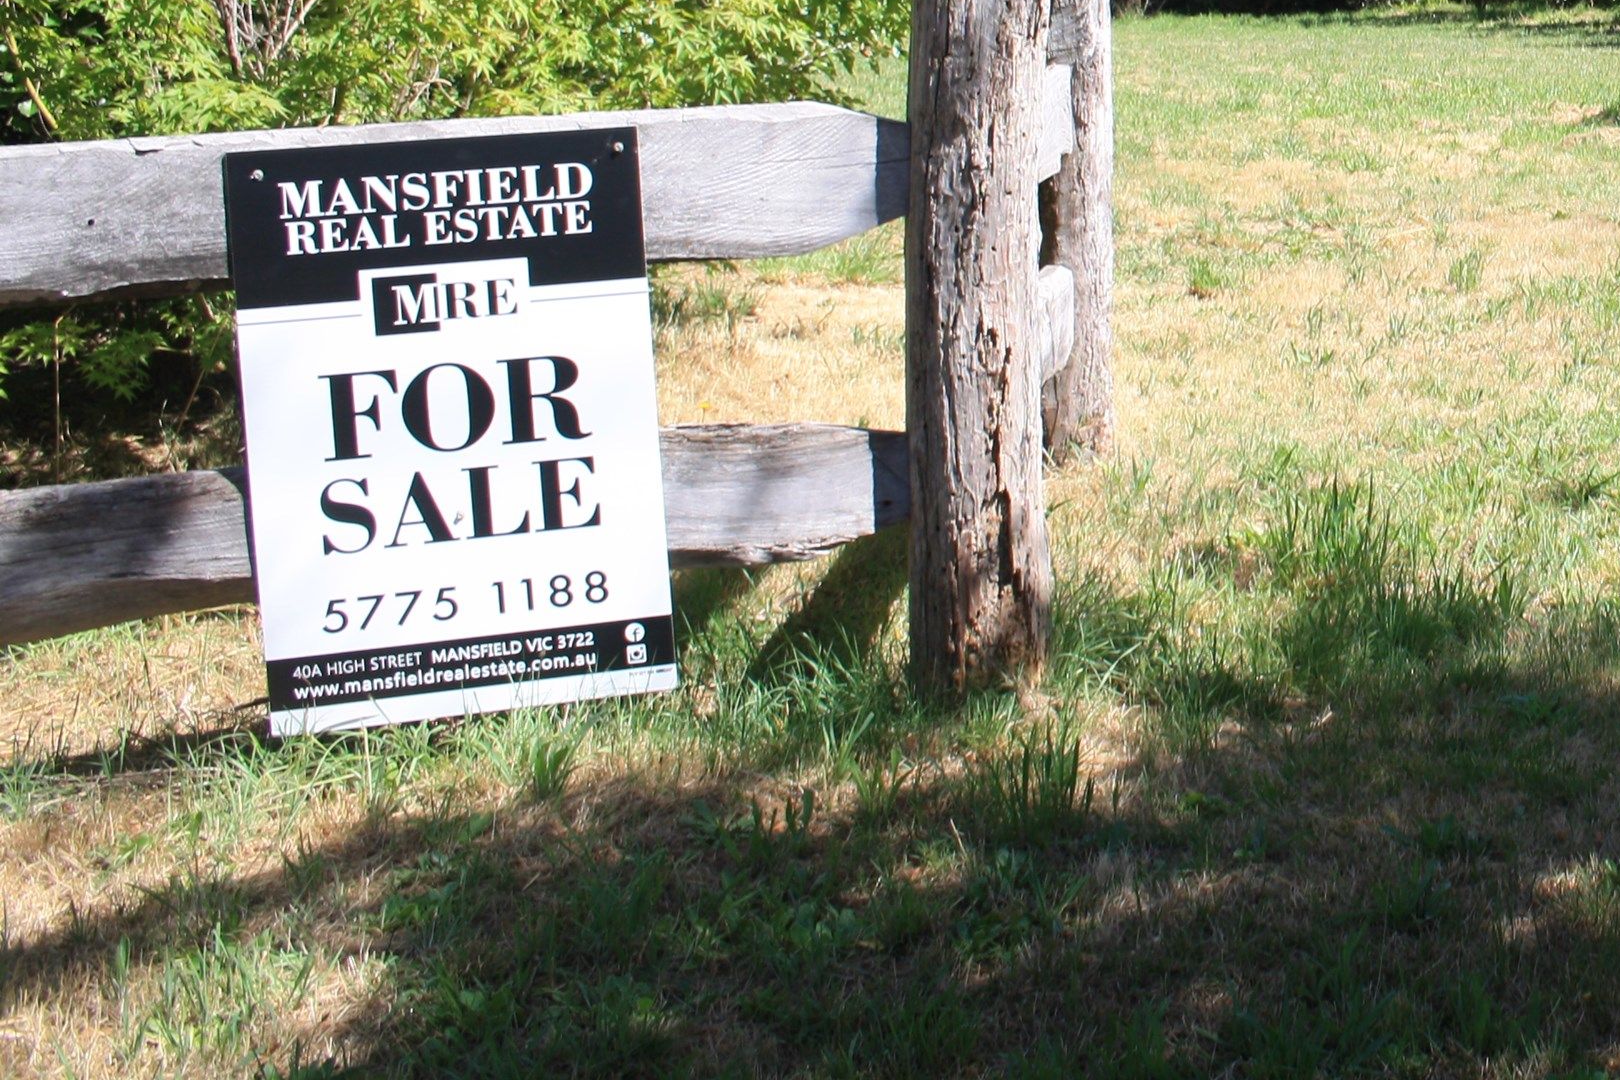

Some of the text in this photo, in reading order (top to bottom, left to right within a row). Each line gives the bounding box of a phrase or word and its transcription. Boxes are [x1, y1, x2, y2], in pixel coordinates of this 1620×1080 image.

[277, 162, 593, 220] MANSFIELD
[286, 200, 593, 256] REAL ESTATE
[391, 277, 518, 326] MRE
[317, 355, 593, 461] FOR
[320, 456, 601, 556] SALE
[322, 570, 609, 634] 5775 1188
[293, 631, 595, 679] 40A HIGH STREET MANSFIELD VIC 3722
[293, 652, 597, 700] www.mansfieldrealestate.com.au
